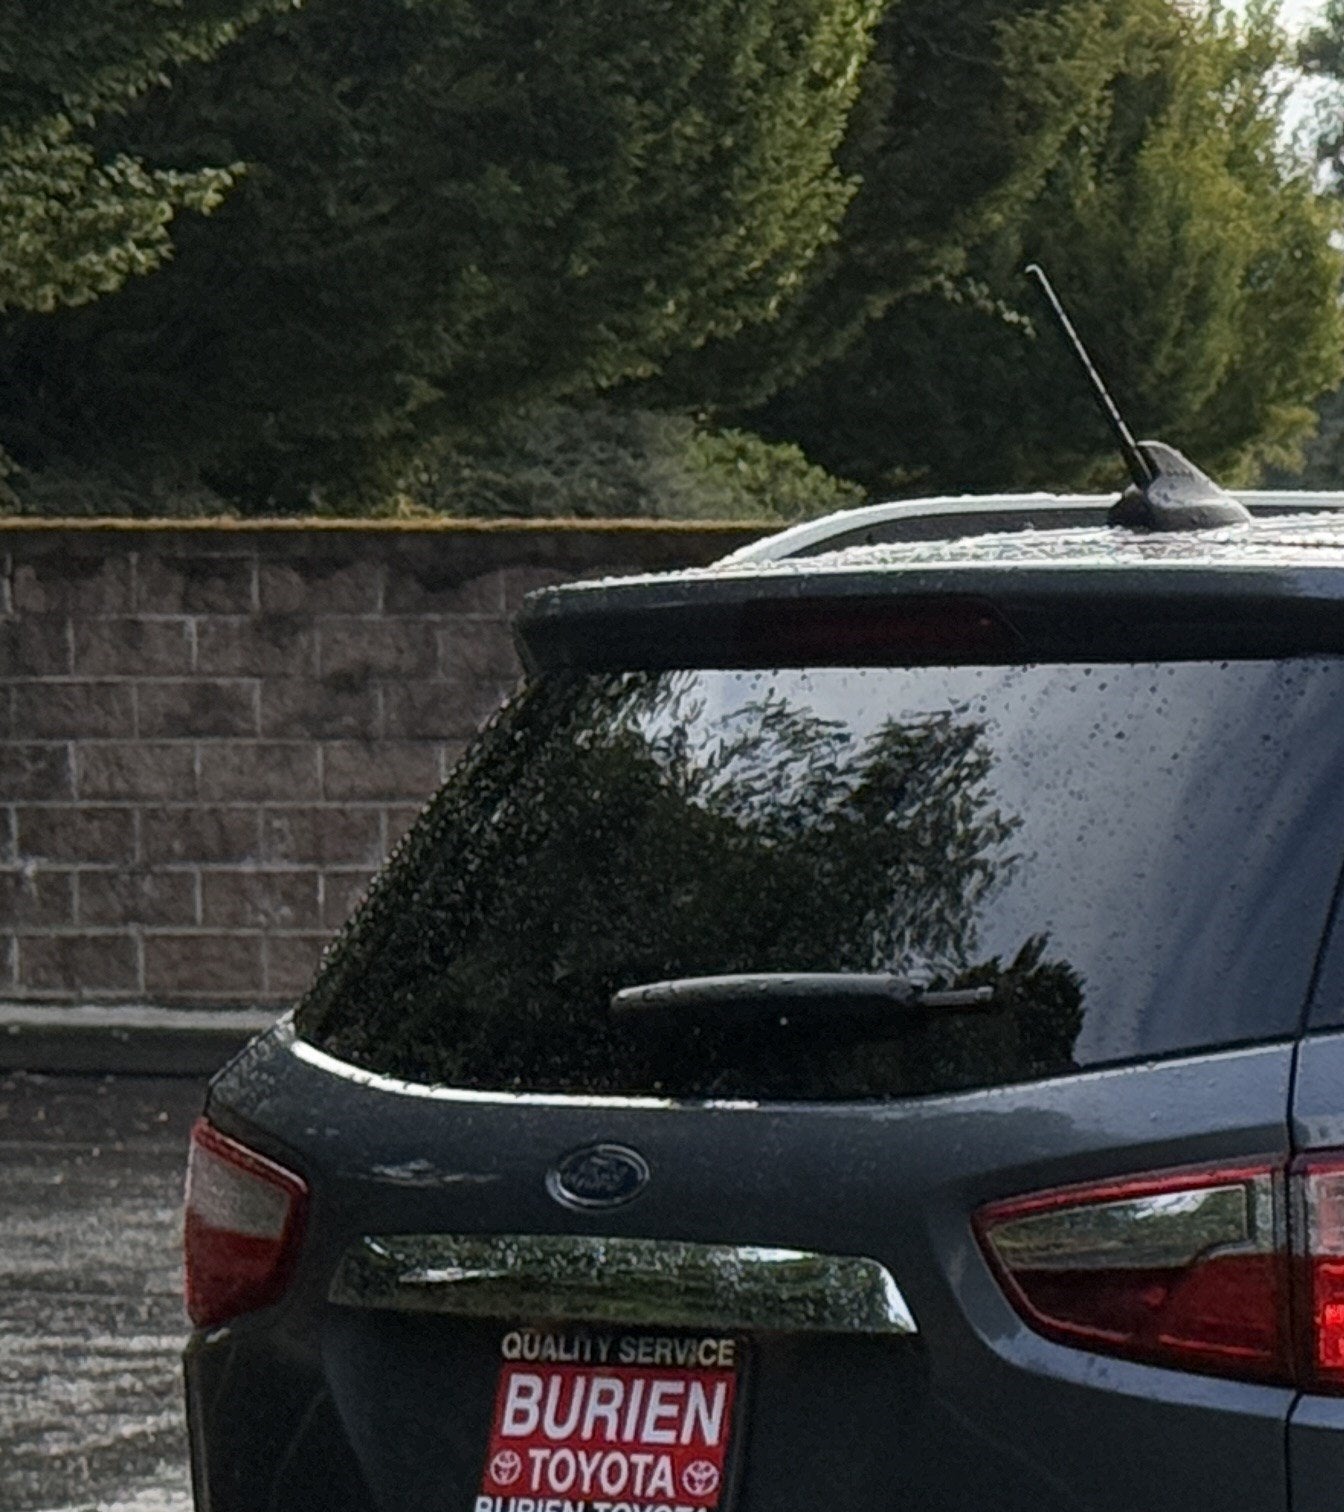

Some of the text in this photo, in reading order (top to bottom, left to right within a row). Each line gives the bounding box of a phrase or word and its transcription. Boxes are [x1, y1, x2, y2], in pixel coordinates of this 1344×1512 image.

[501, 1331, 736, 1367] QUALITY SERVICE
[500, 1373, 728, 1447] BURIEN
[527, 1448, 677, 1499] TOYOTA
